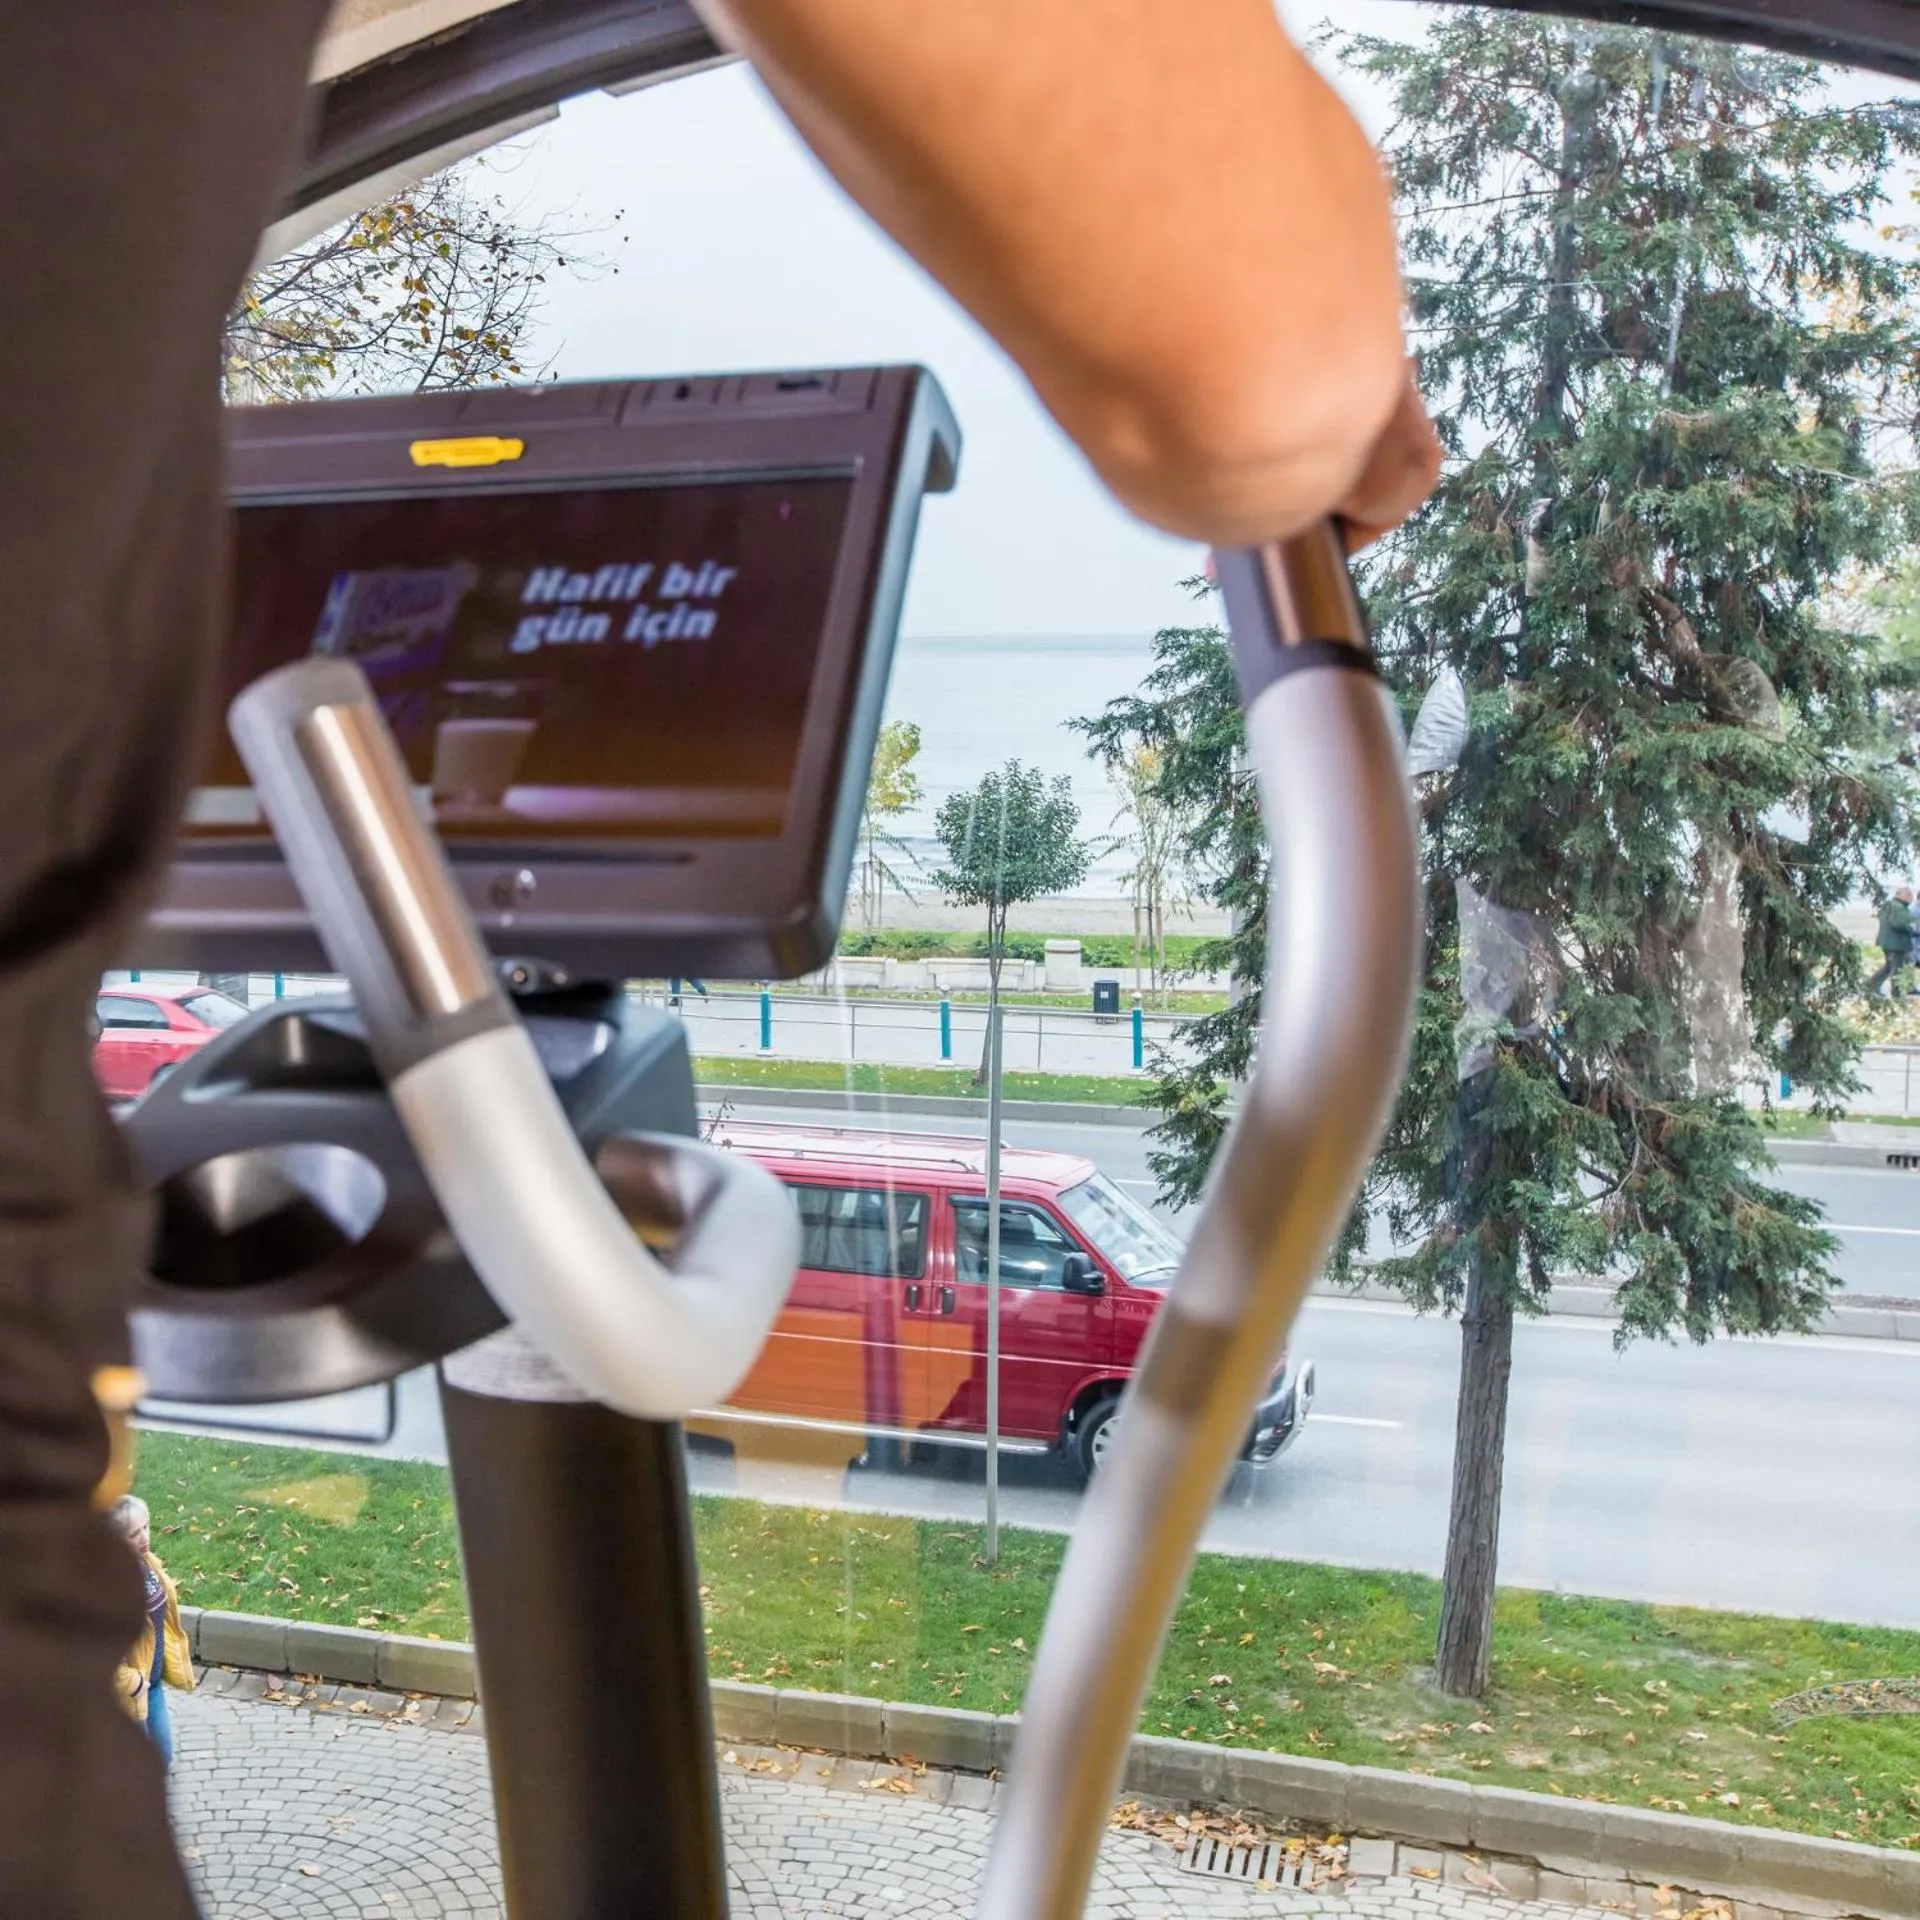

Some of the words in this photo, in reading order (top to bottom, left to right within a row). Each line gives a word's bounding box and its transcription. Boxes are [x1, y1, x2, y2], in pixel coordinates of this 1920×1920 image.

[522, 562, 654, 603] Hafif
[659, 560, 738, 597] bir
[509, 605, 612, 653] gün
[622, 602, 718, 651] için
